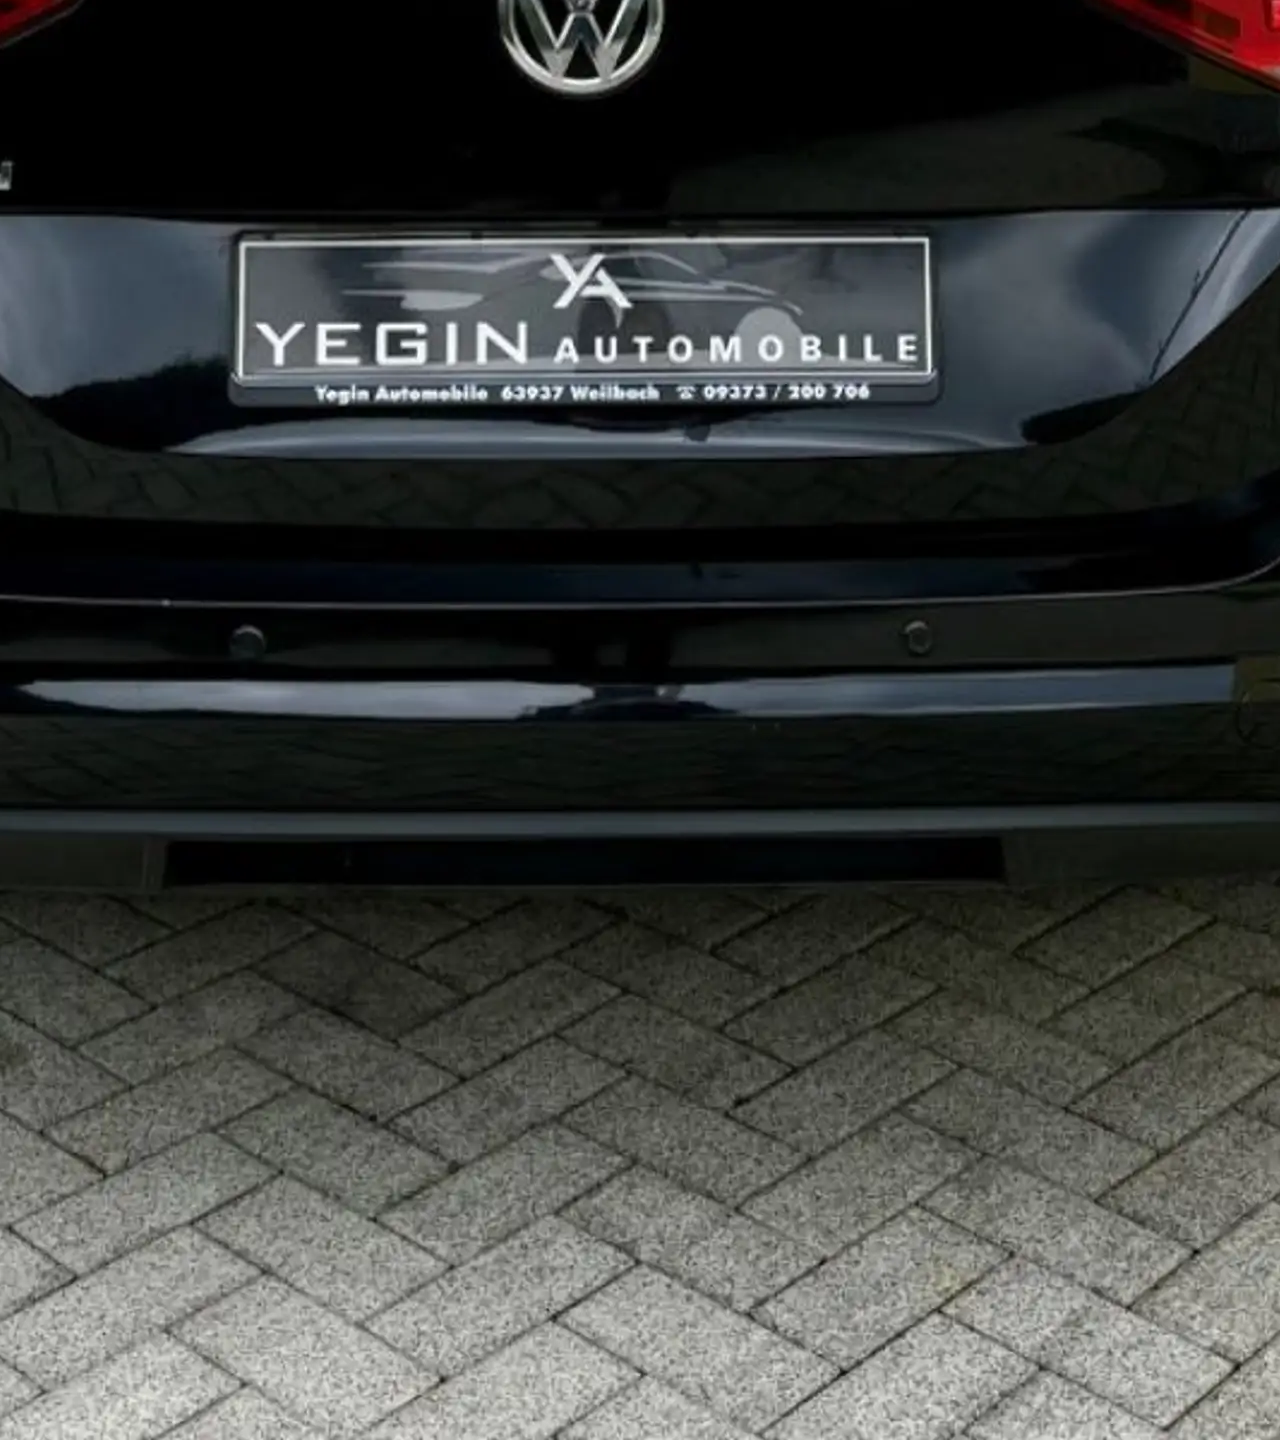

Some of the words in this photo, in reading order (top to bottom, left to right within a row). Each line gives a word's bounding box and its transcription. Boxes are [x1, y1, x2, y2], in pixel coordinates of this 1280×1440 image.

[255, 321, 528, 366] YEGIN
[554, 334, 919, 363] AUTOMOBILE
[314, 384, 370, 406] Yegin
[374, 384, 488, 402] Automobile
[500, 385, 564, 402] 63937
[570, 383, 660, 401] Weilbach
[703, 384, 767, 401] 09373
[788, 384, 826, 401] 200
[832, 384, 871, 401] 706
